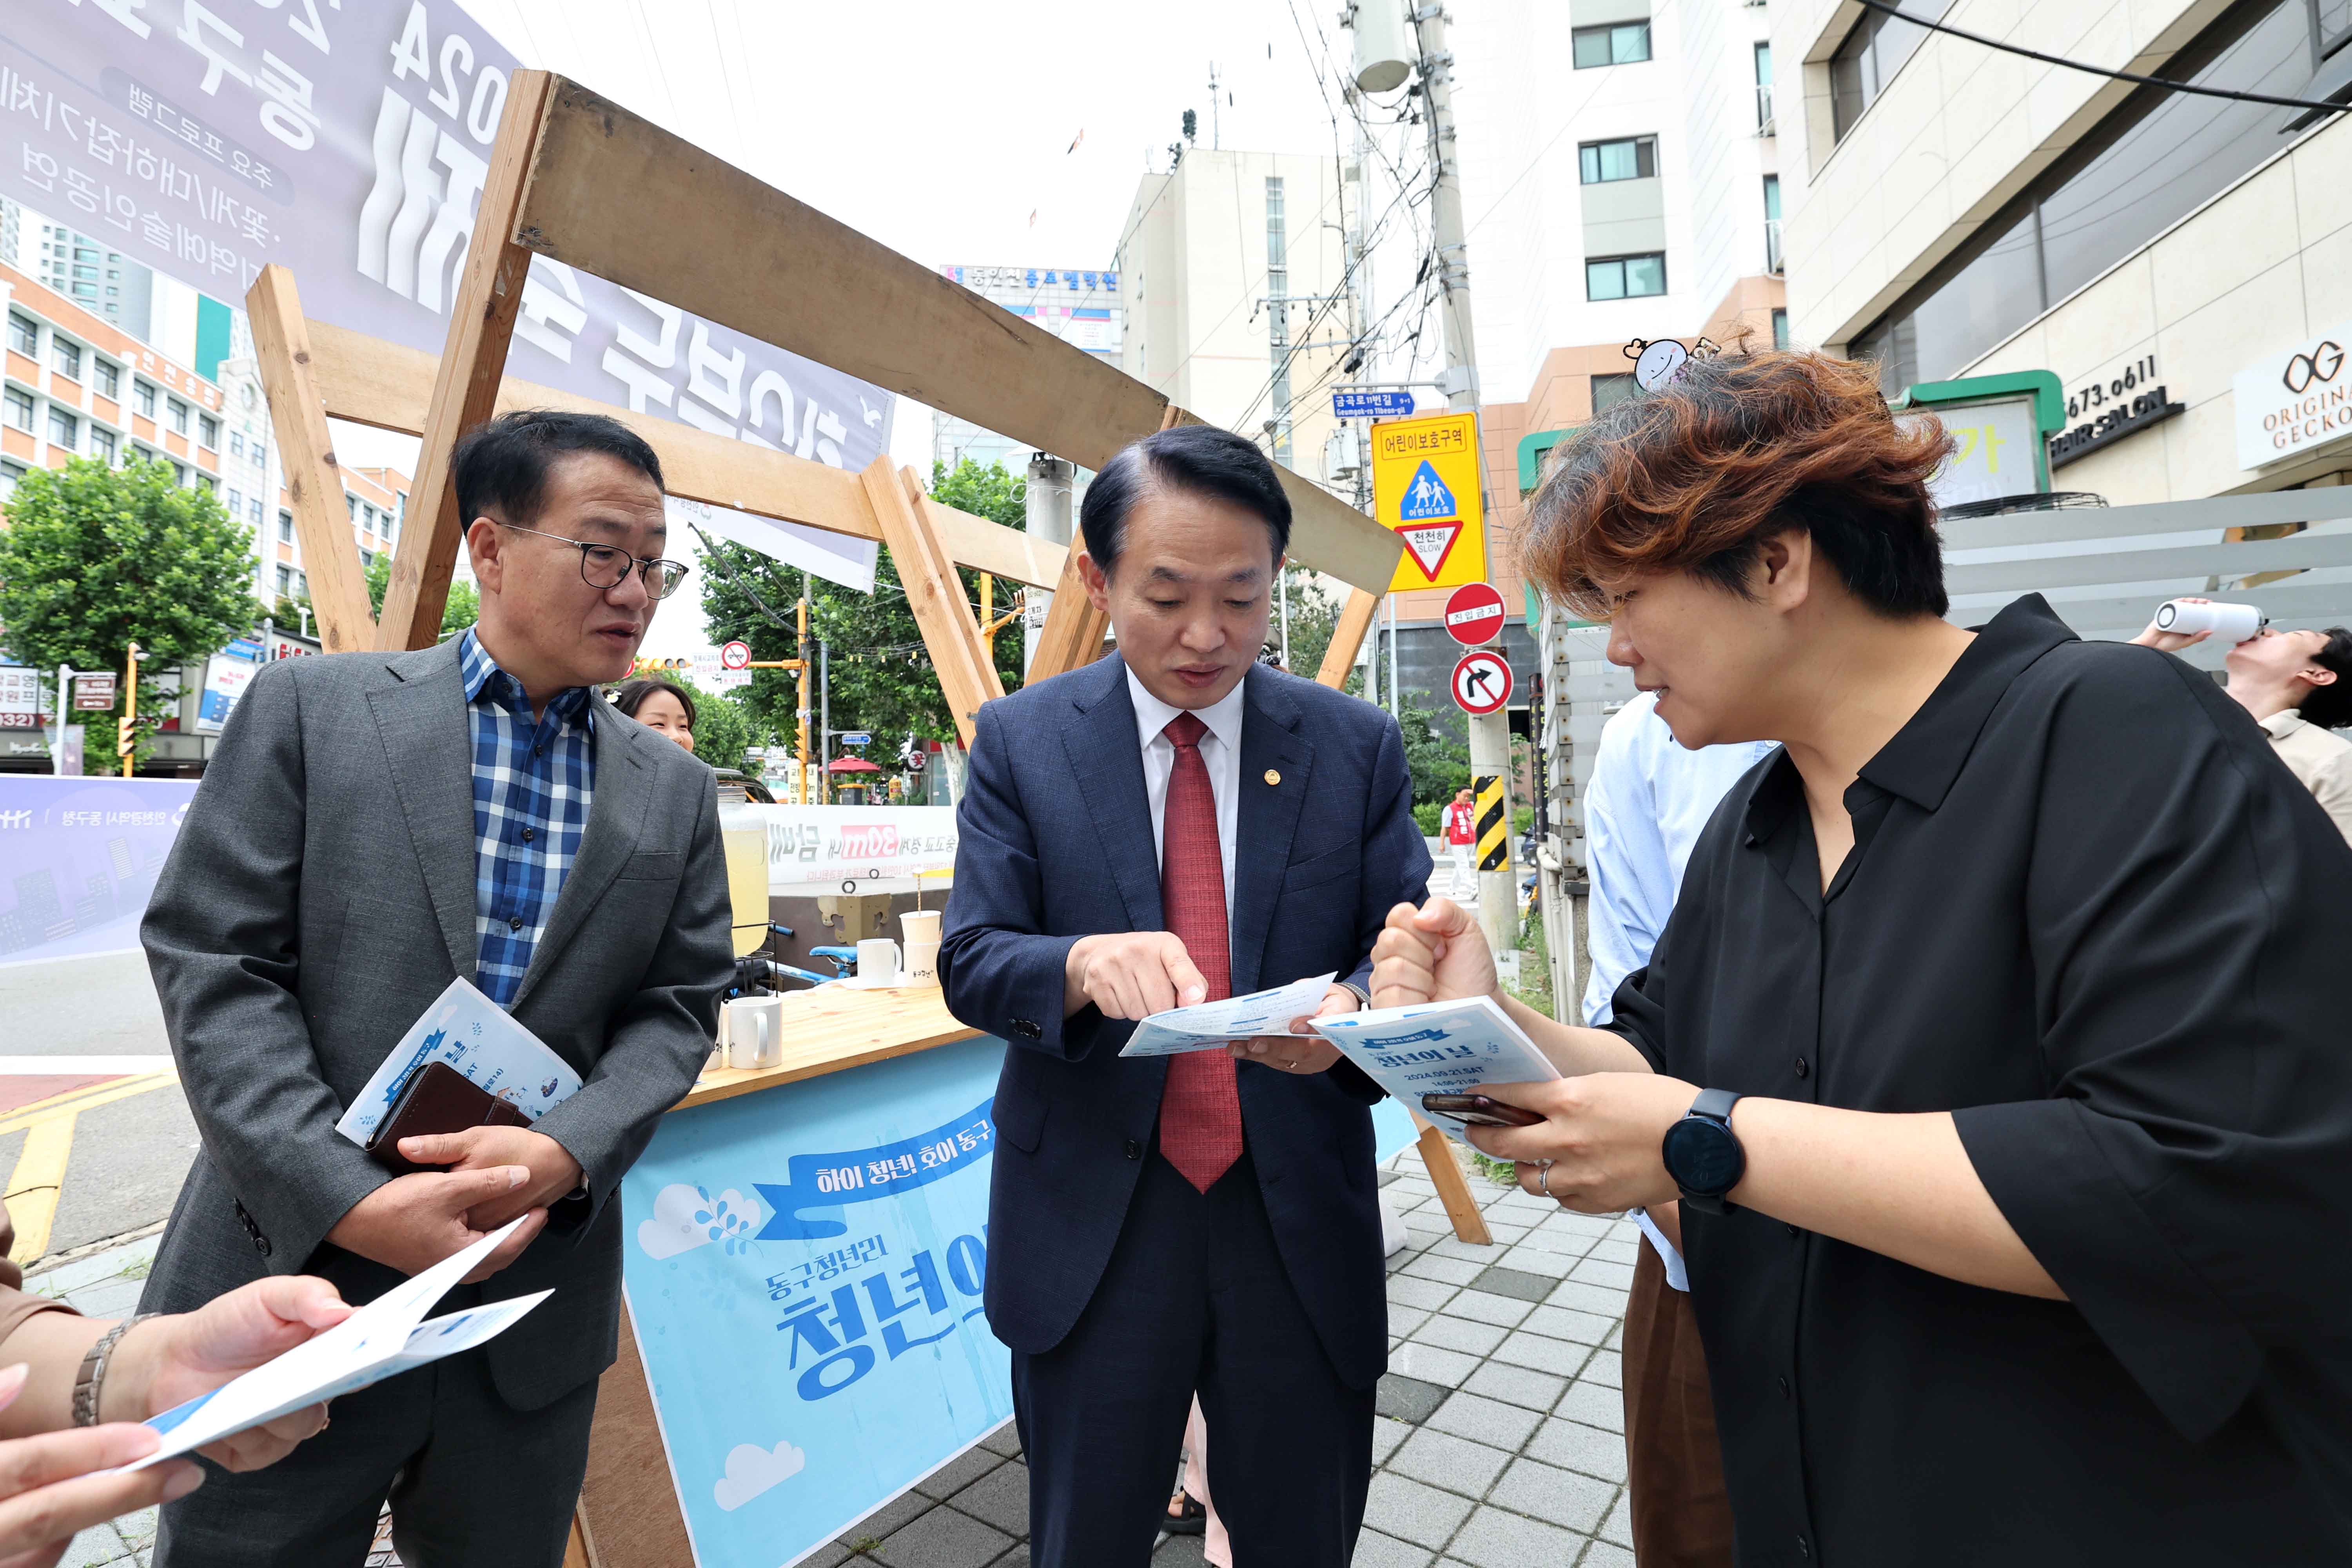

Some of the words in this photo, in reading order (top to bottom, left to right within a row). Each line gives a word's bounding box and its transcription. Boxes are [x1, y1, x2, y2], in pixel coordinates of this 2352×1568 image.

[2065, 354, 2155, 418] 673.0611
[1335, 394, 1392, 407] 금곡로11번길
[2274, 406, 2352, 448] GECKO
[1385, 428, 1462, 454] 어린이보호구역
[1408, 507, 1450, 517] 어린이보호
[1413, 530, 1446, 544] 천천히
[1418, 544, 1441, 554] SLOW
[1454, 606, 1497, 622] 진입금지
[1444, 1045, 1477, 1058] 날
[815, 1165, 864, 1194] 하이
[866, 1154, 916, 1185] 청년!
[919, 1137, 960, 1173] 호이
[955, 1120, 993, 1155] 동구
